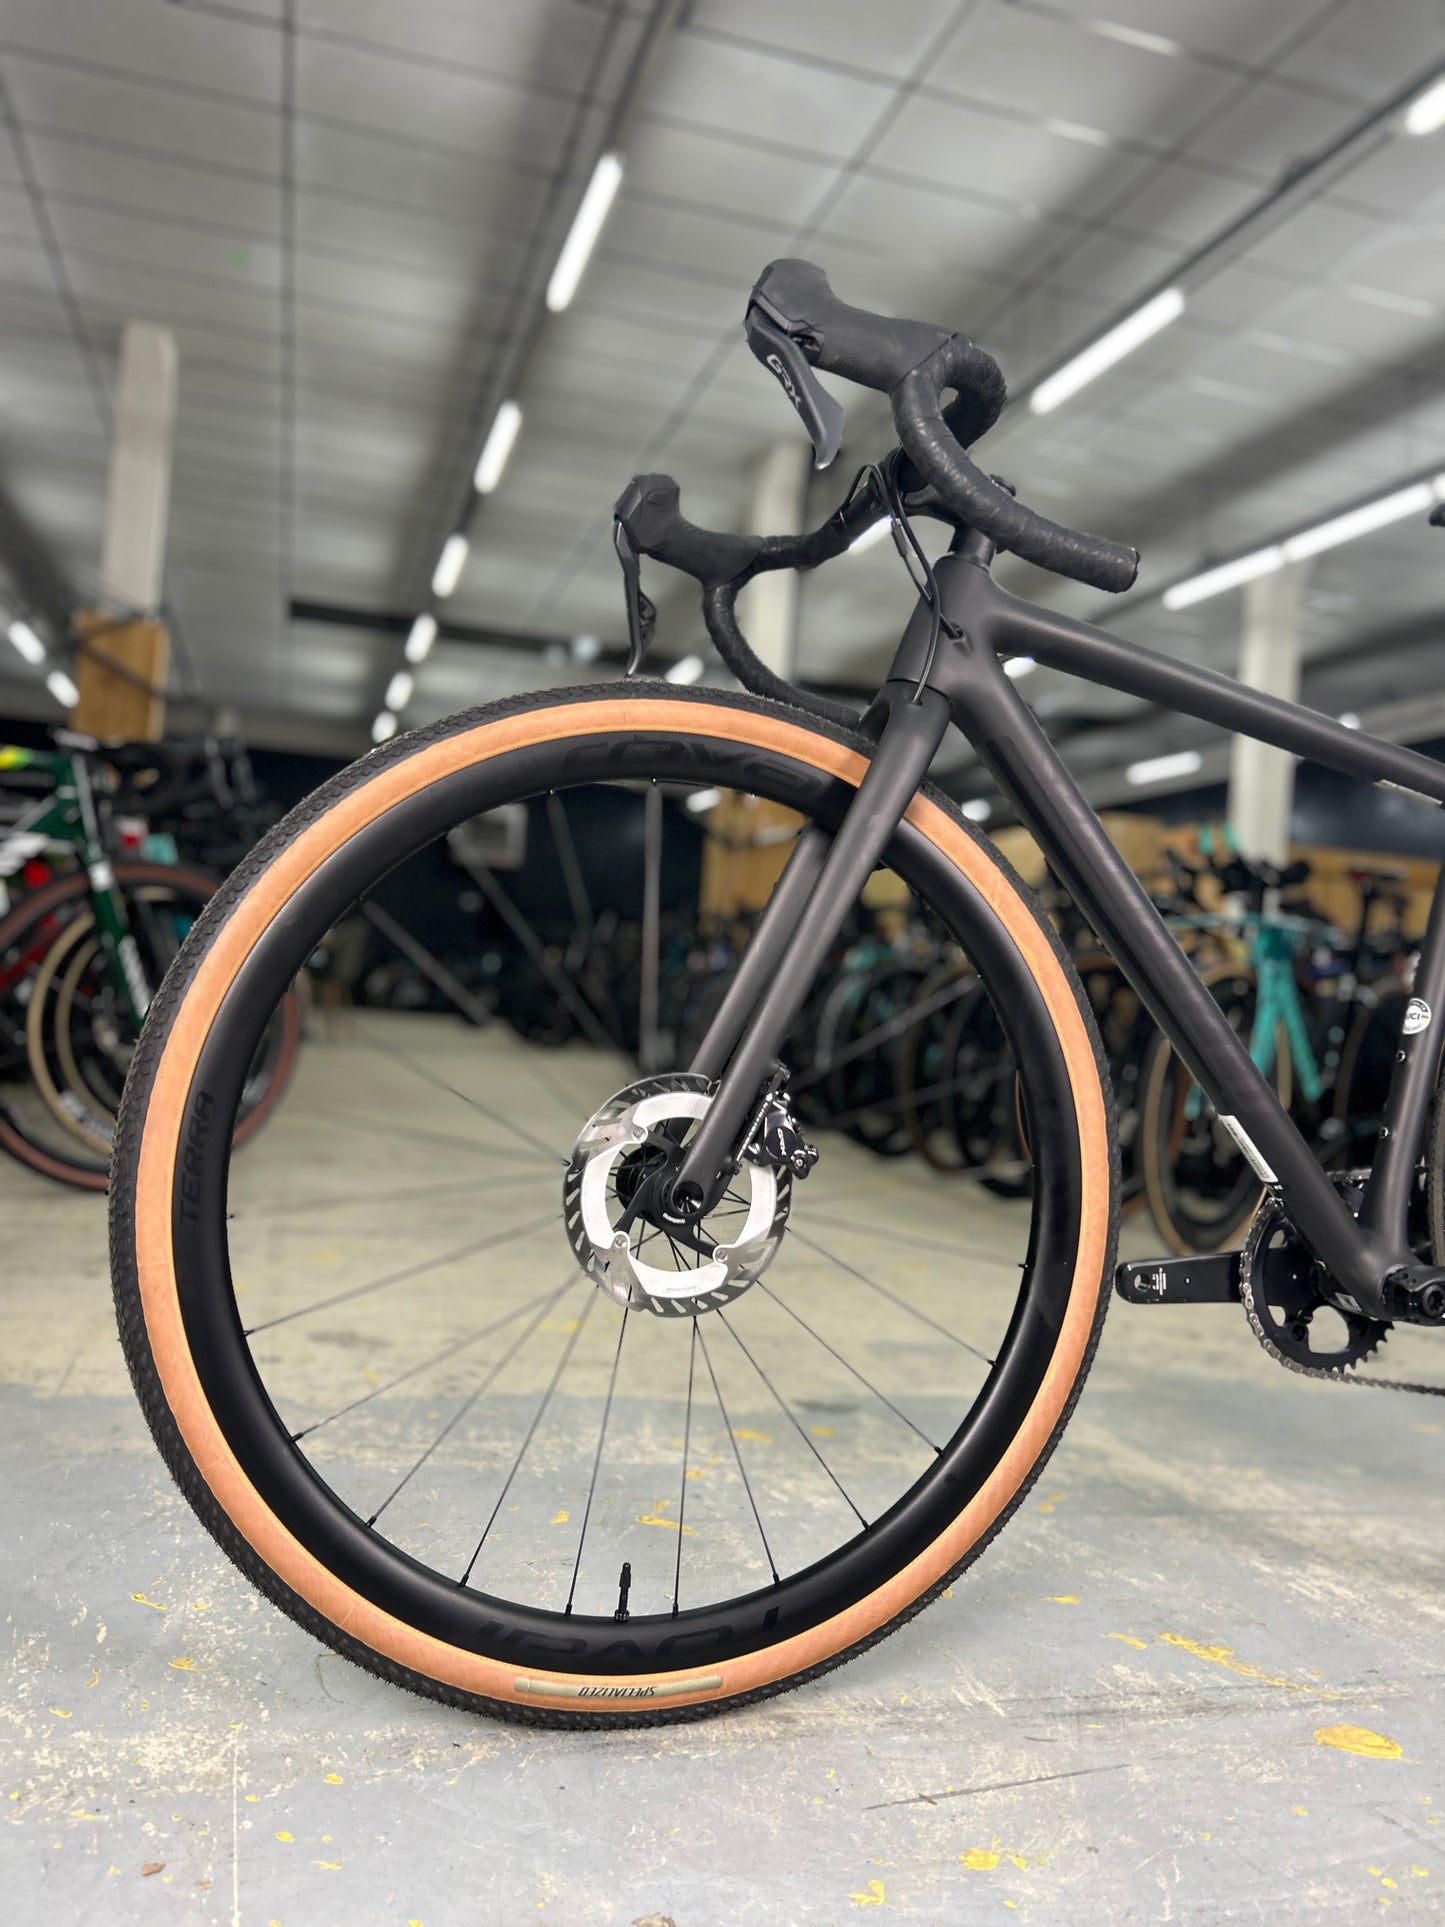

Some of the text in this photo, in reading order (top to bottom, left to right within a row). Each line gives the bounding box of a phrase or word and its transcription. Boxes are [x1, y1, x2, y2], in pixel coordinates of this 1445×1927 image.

[766, 354, 801, 410] GRX
[180, 1090, 214, 1224] TERRA
[577, 1685, 657, 1698] SPECIALIZED
